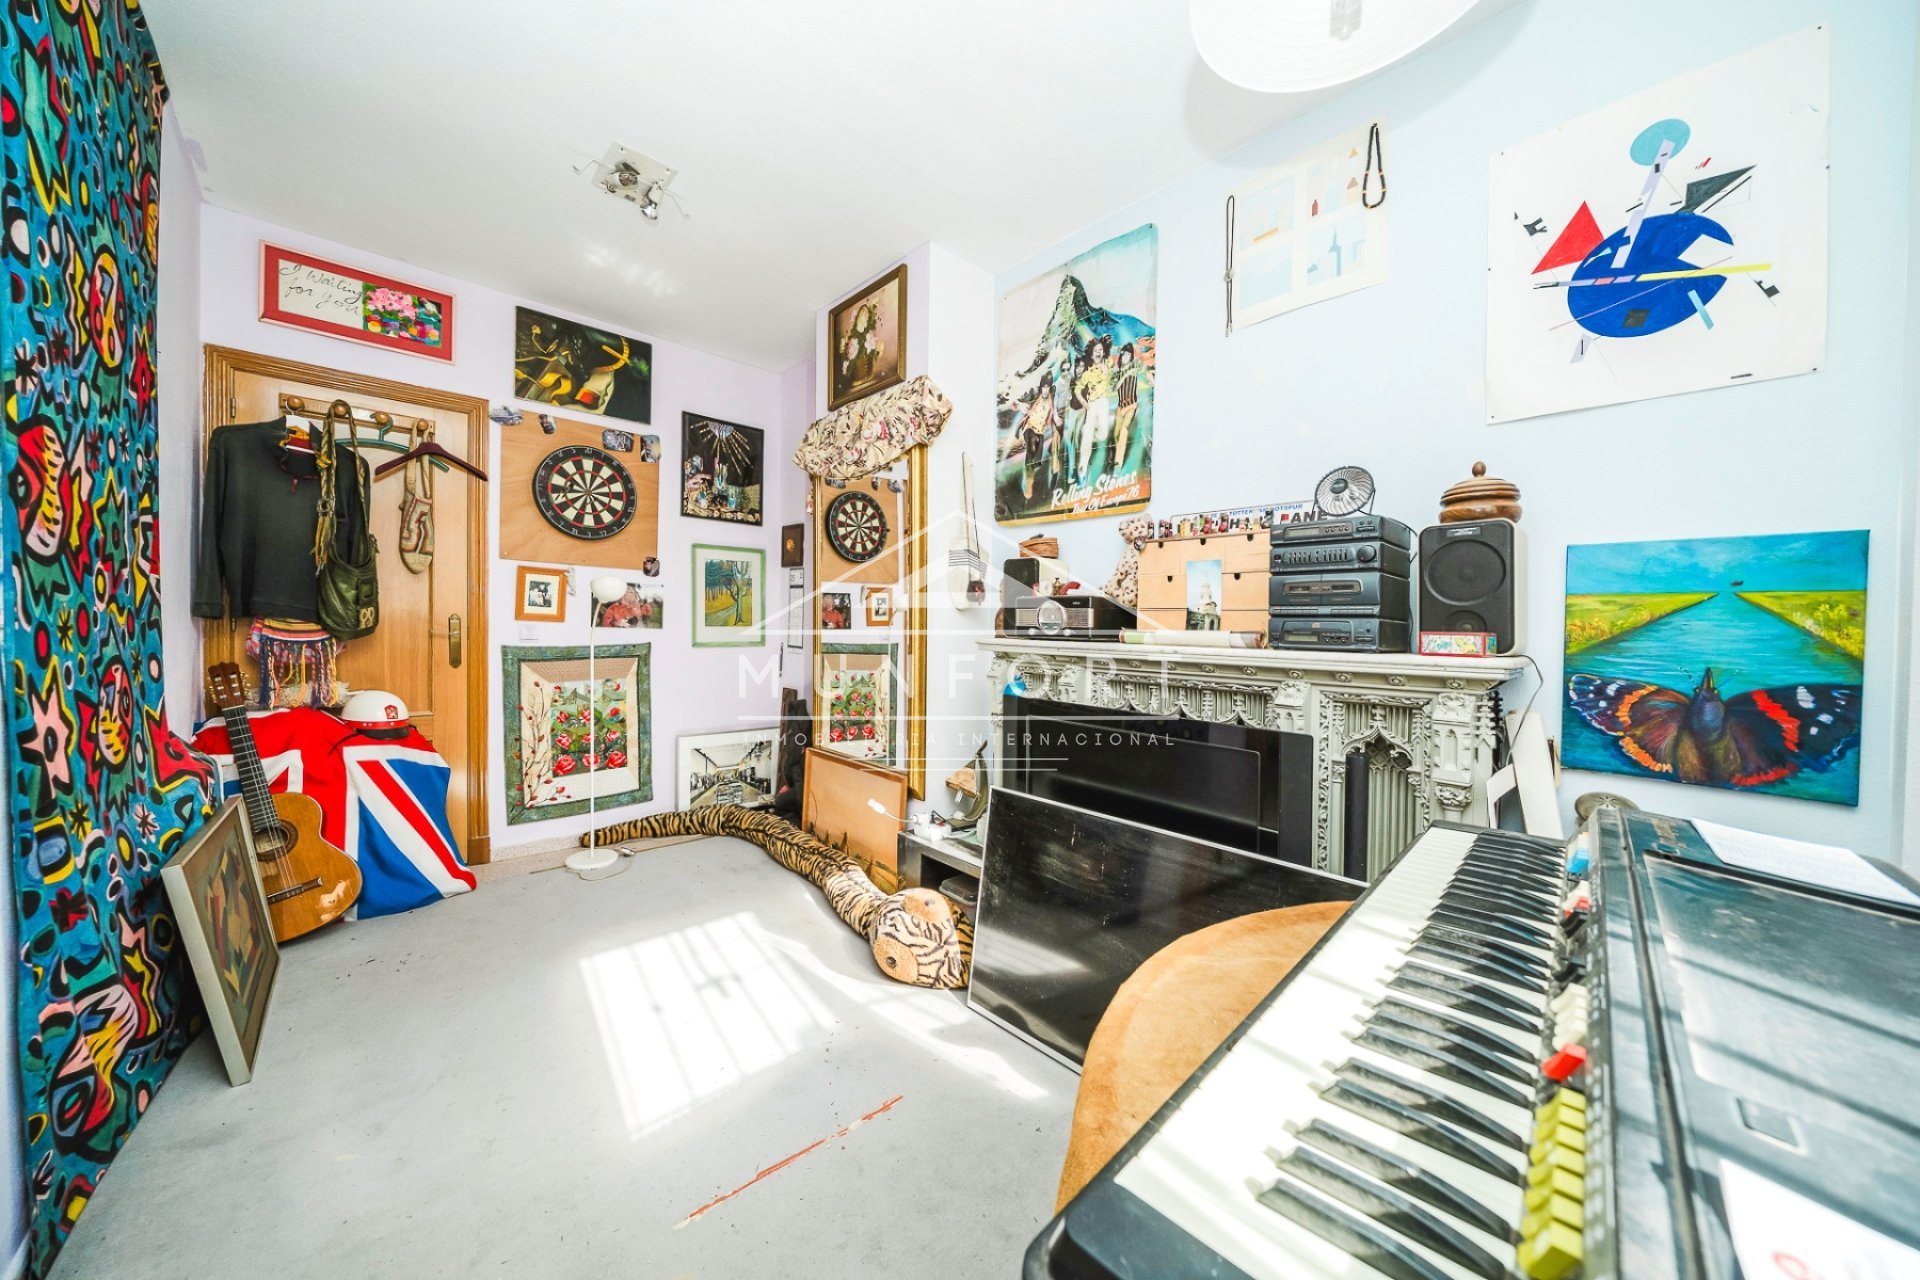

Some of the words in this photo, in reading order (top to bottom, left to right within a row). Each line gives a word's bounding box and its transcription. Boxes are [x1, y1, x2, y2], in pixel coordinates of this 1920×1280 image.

[284, 277, 313, 298] for
[315, 292, 359, 314] you
[306, 271, 362, 305] Waiting
[1051, 484, 1093, 510] Rolling
[1093, 471, 1137, 496] Stones
[1272, 503, 1303, 512] OTSPUR
